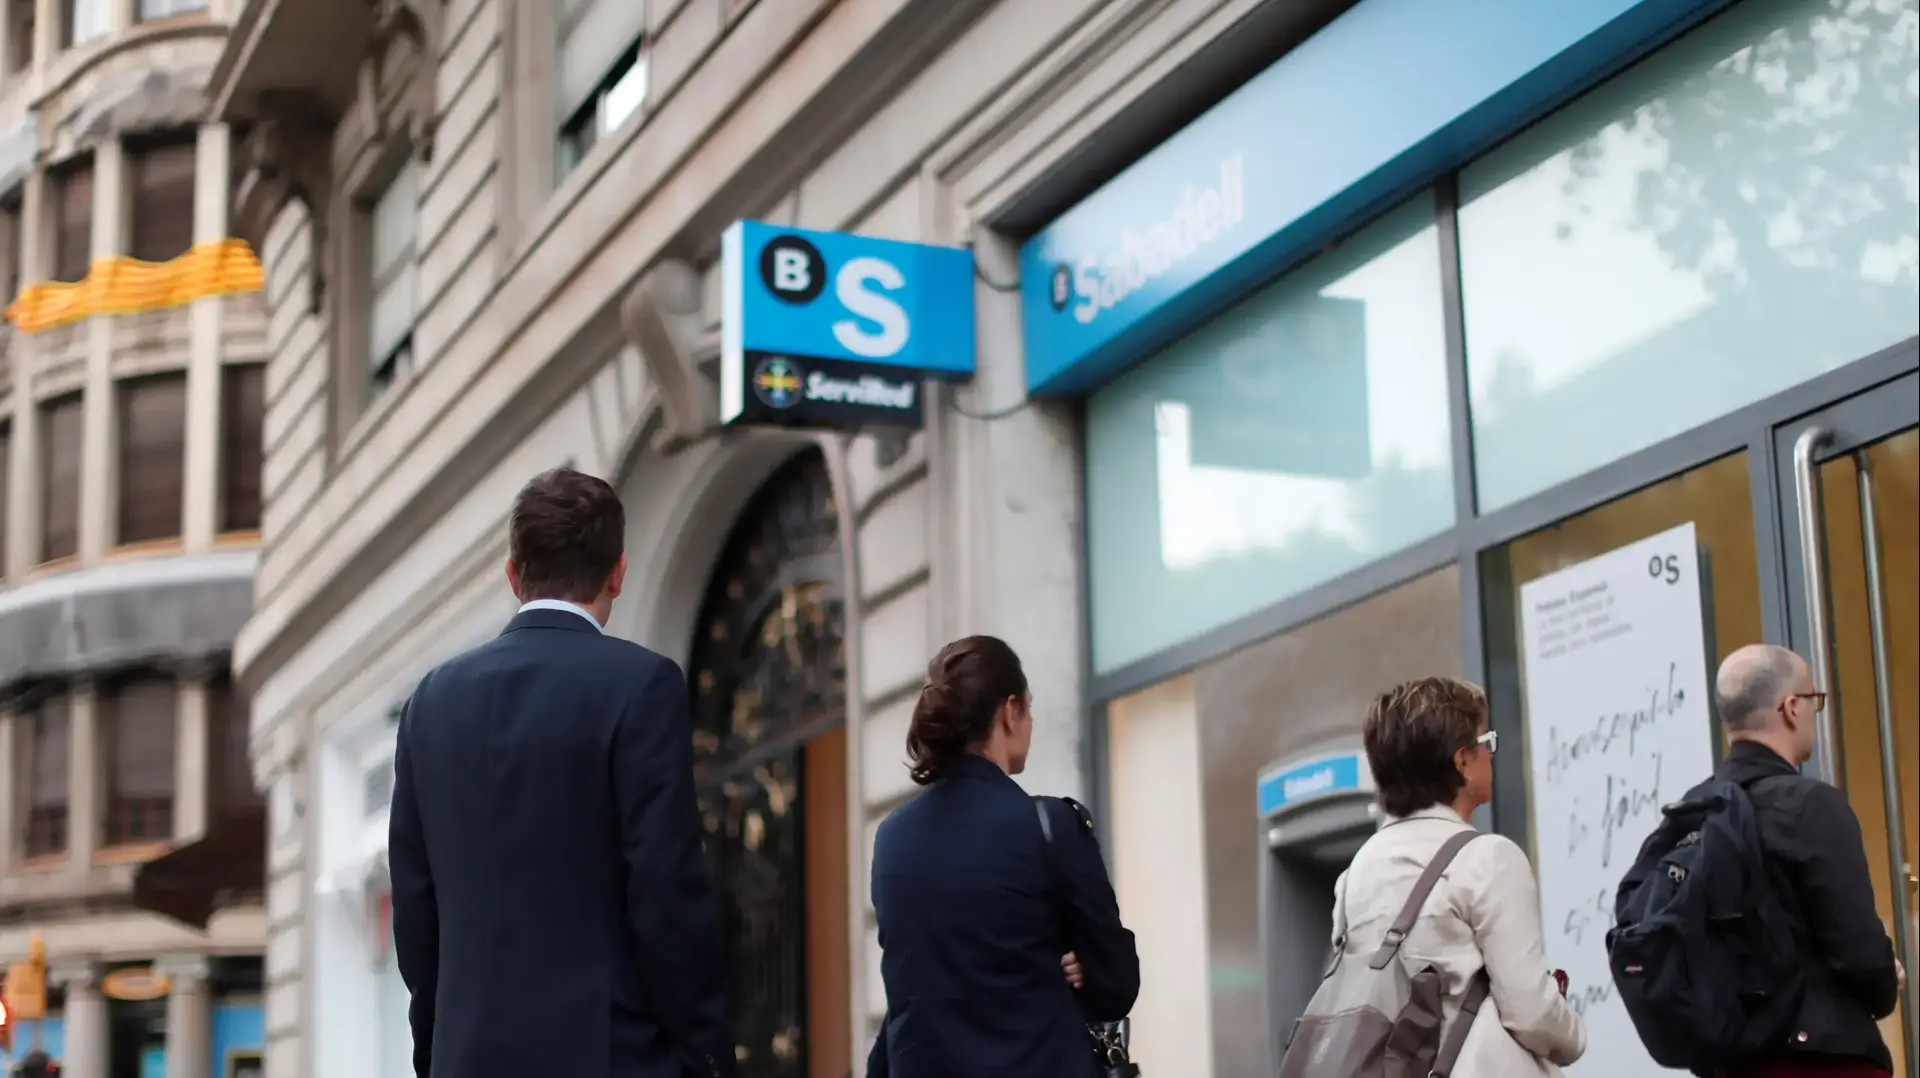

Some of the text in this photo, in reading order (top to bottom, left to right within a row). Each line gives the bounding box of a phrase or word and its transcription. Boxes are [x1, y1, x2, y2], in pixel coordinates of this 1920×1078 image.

[1074, 154, 1243, 323] Sabadell
[774, 248, 910, 358] B S
[806, 370, 914, 408] ServiRed
